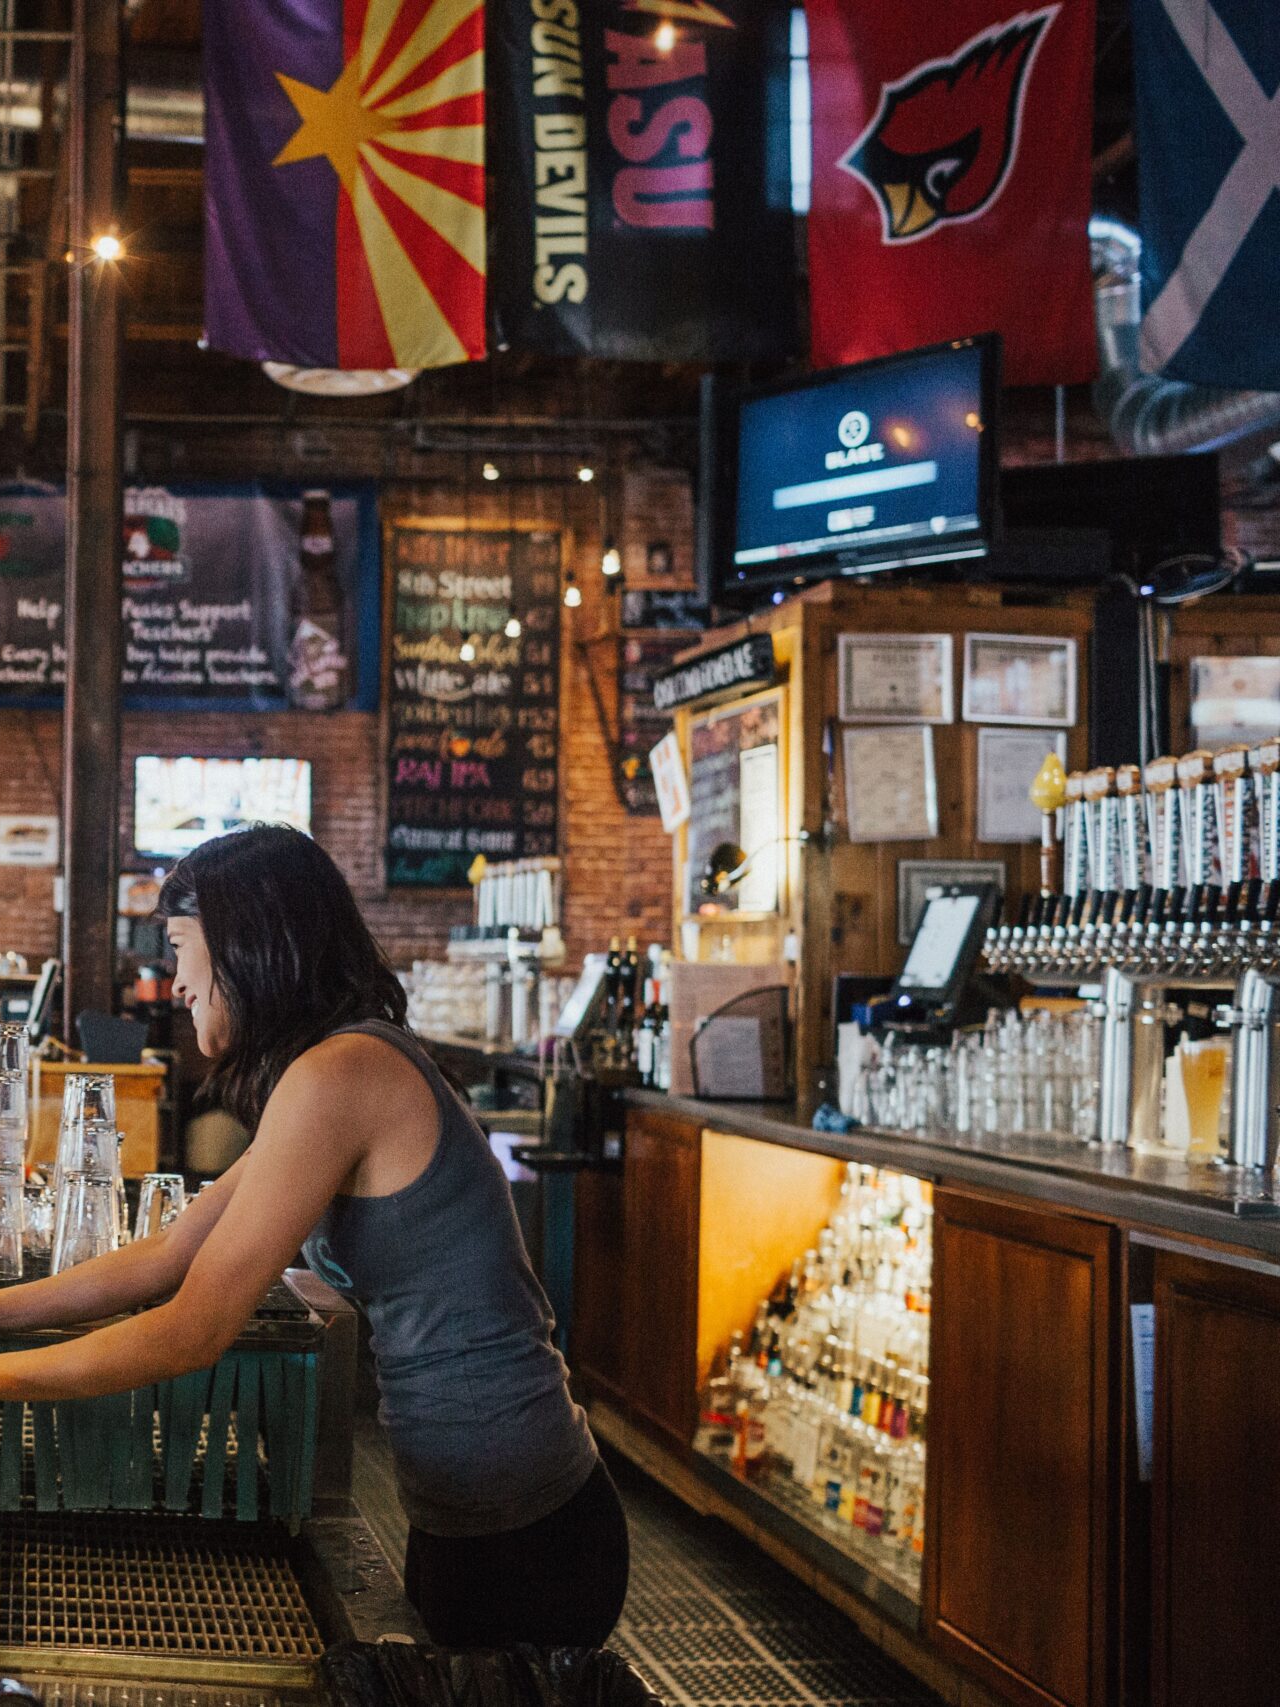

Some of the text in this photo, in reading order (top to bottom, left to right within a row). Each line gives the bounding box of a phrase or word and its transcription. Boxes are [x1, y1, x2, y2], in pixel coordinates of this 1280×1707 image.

[531, 0, 588, 304] SUN DEVILS
[604, 28, 715, 231] ASU
